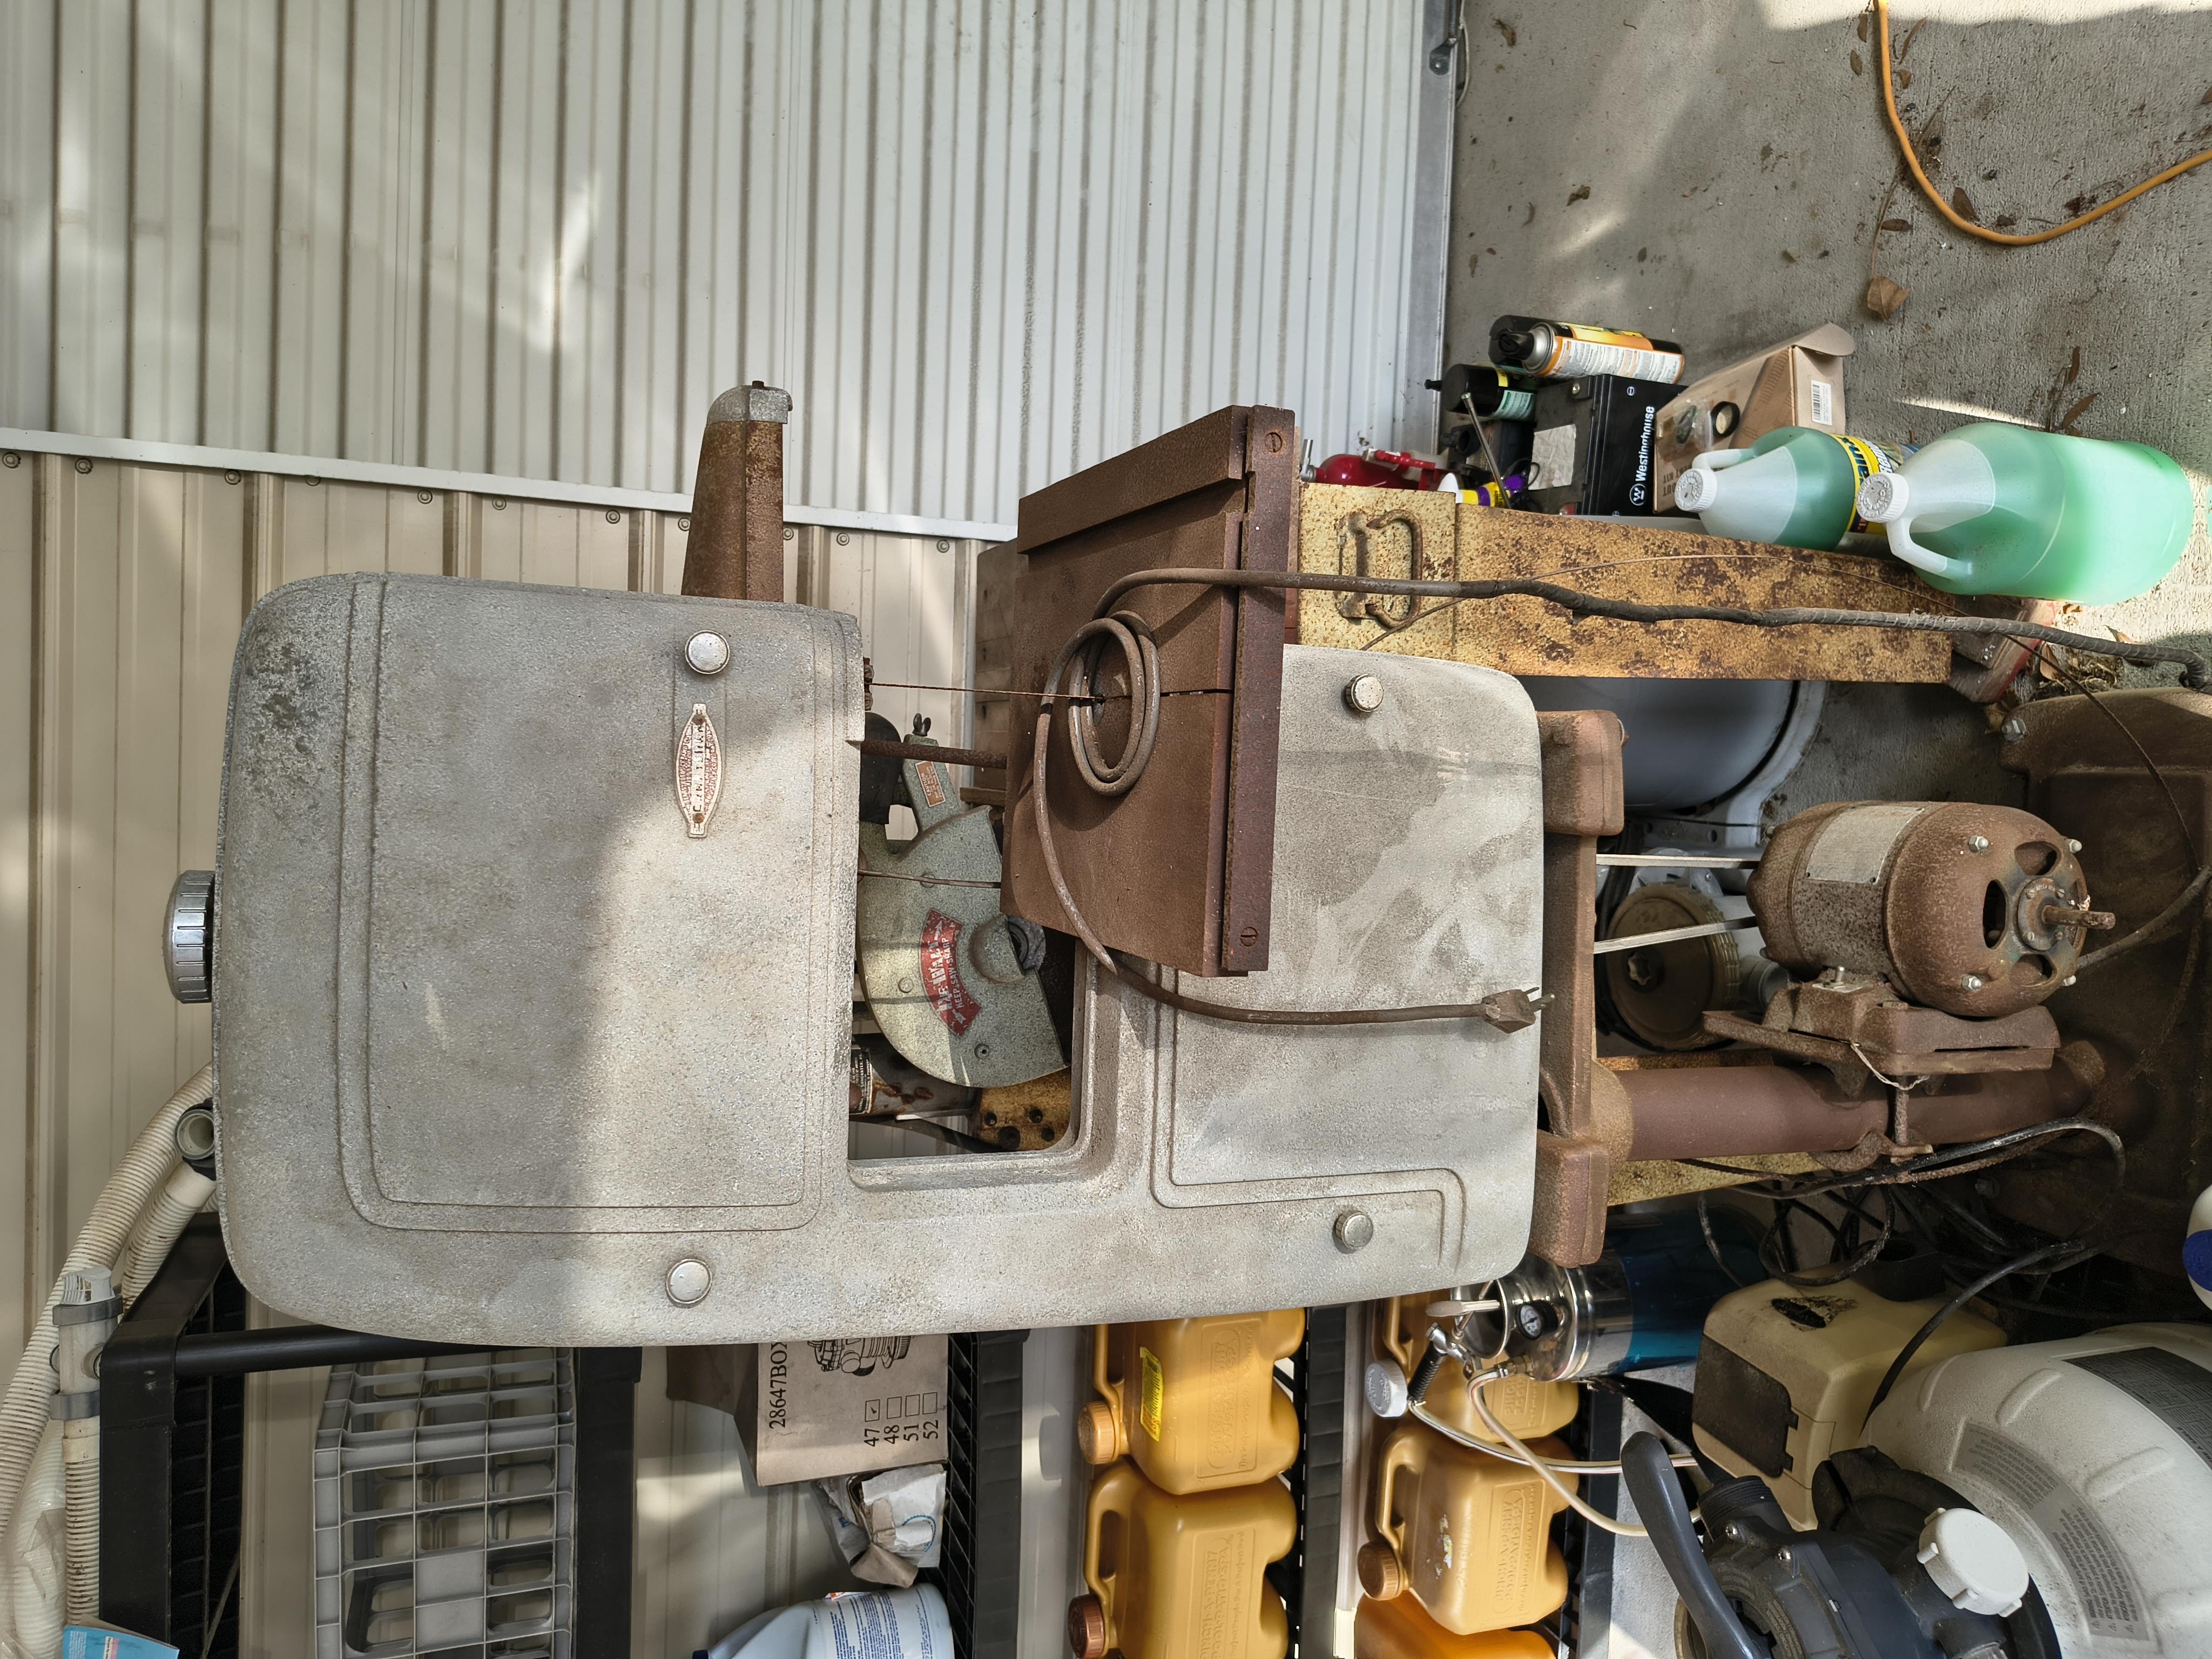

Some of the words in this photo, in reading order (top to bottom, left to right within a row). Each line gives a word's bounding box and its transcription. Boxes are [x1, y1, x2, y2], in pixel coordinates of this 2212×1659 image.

[1635, 406, 1654, 482] Westinghouse
[920, 773, 932, 796] CAUTION
[941, 938, 954, 964] SHARP
[949, 967, 958, 984] SAW
[953, 987, 965, 1009] KEEP
[864, 1428, 880, 1447] 47
[884, 1424, 900, 1445] 48
[903, 1423, 919, 1441] 51
[922, 1419, 939, 1440] 52
